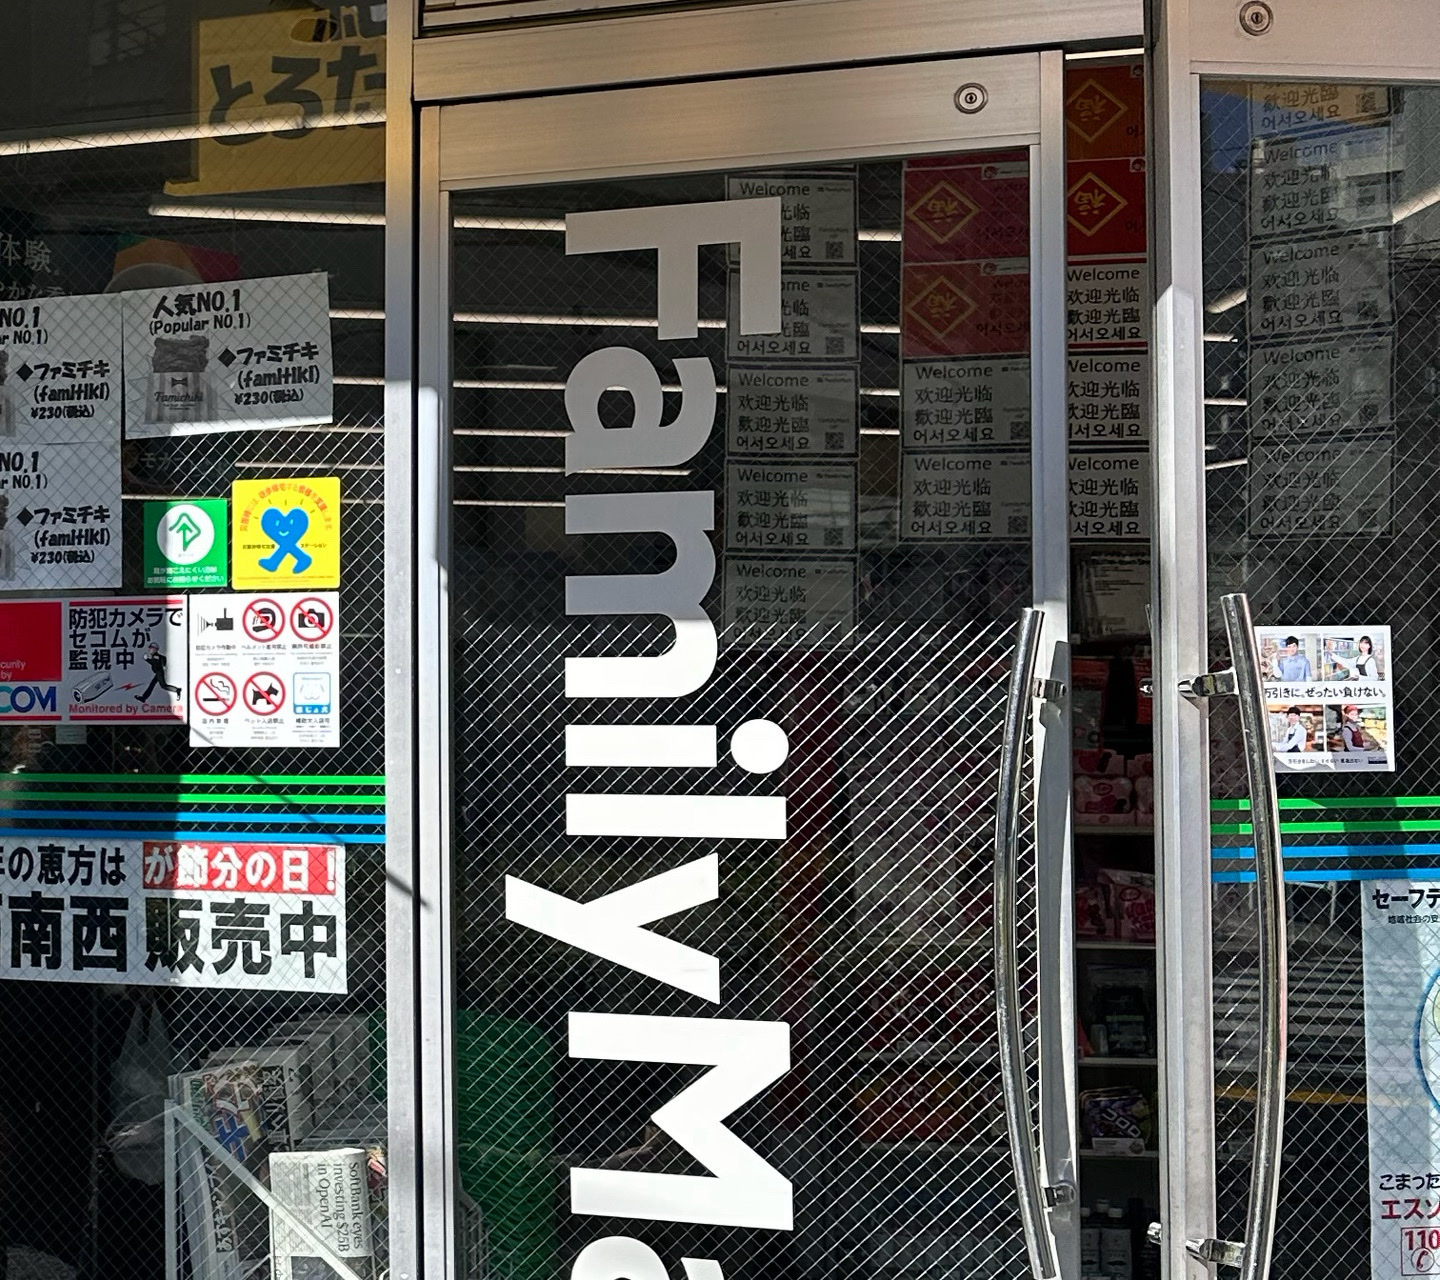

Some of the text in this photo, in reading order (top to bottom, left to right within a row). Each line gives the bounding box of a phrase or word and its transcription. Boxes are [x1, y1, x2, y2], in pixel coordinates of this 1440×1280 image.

[740, 182, 810, 196] Welcome
[1068, 268, 1140, 282] Welcome
[153, 289, 240, 319] 人気NO.1
[1068, 286, 1140, 304] 欢迎光临
[149, 312, 251, 335] (Popular NO.1)
[13, 328, 48, 346] NO.1)
[1068, 326, 1141, 341] 어서오세요
[236, 341, 319, 366] ファミチキ
[737, 340, 812, 356] 어서오세요
[34, 360, 111, 381] ファミチキ
[916, 364, 993, 380] Welcome
[738, 373, 809, 388] Welcome
[914, 457, 992, 472] Welcome
[12, 473, 48, 490] NO.1)
[738, 469, 808, 483] Welcome
[34, 505, 111, 525] ファミチキ
[1073, 520, 1141, 535] 서오세요
[68, 607, 184, 630] 防犯カメラで
[68, 627, 151, 650] セコムが
[68, 649, 135, 671] 監視中
[0, 670, 13, 681] by
[68, 703, 184, 716] Monitored by Camera
[143, 893, 338, 980] 販売中
[332, 1161, 347, 1219] investing
[1379, 1173, 1440, 1191] こまった
[316, 1177, 332, 1229] OpenAI
[348, 1161, 364, 1249] SoftBank eyes
